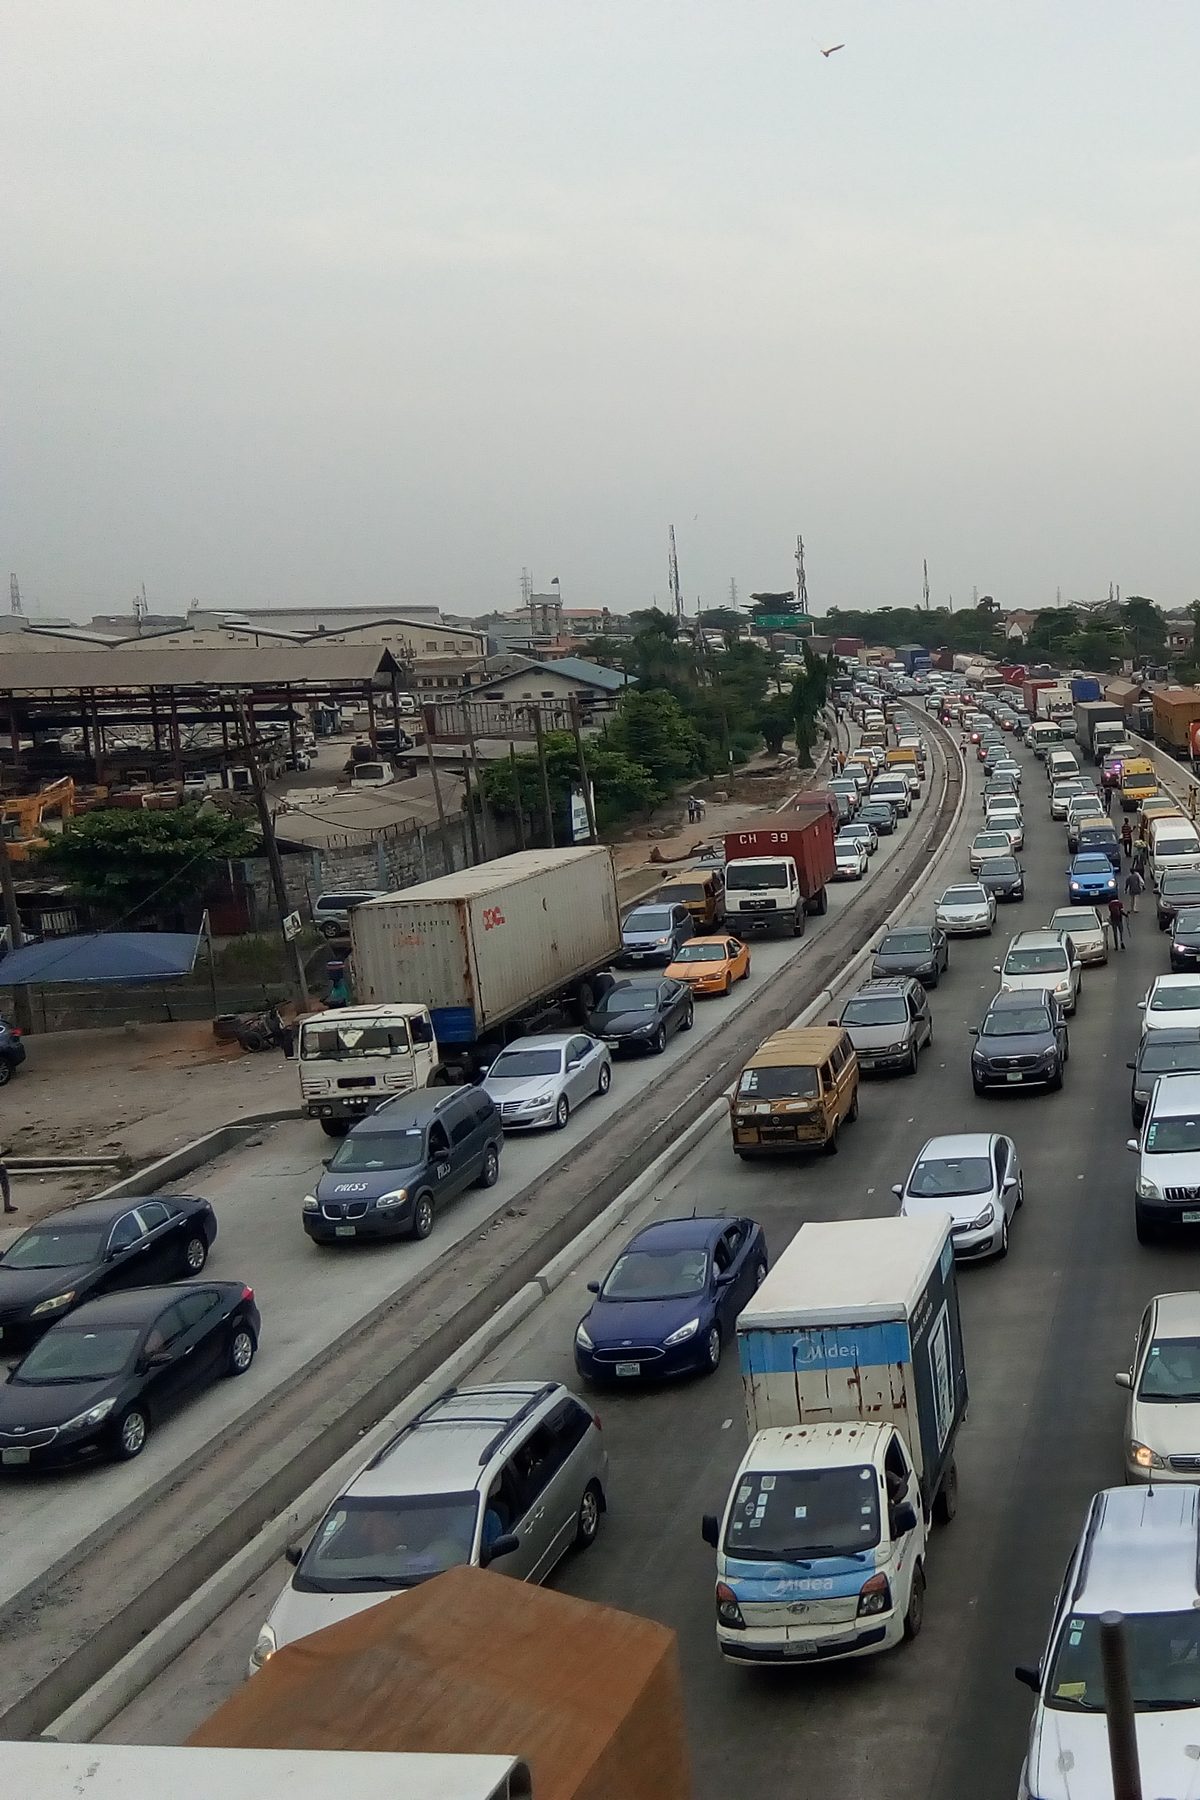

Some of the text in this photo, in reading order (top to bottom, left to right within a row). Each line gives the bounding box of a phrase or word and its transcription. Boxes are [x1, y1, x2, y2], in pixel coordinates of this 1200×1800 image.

[739, 832, 788, 845] CH 39
[334, 1182, 369, 1192] PRESS
[800, 1340, 859, 1362] Midea
[769, 1572, 834, 1594] Midea
